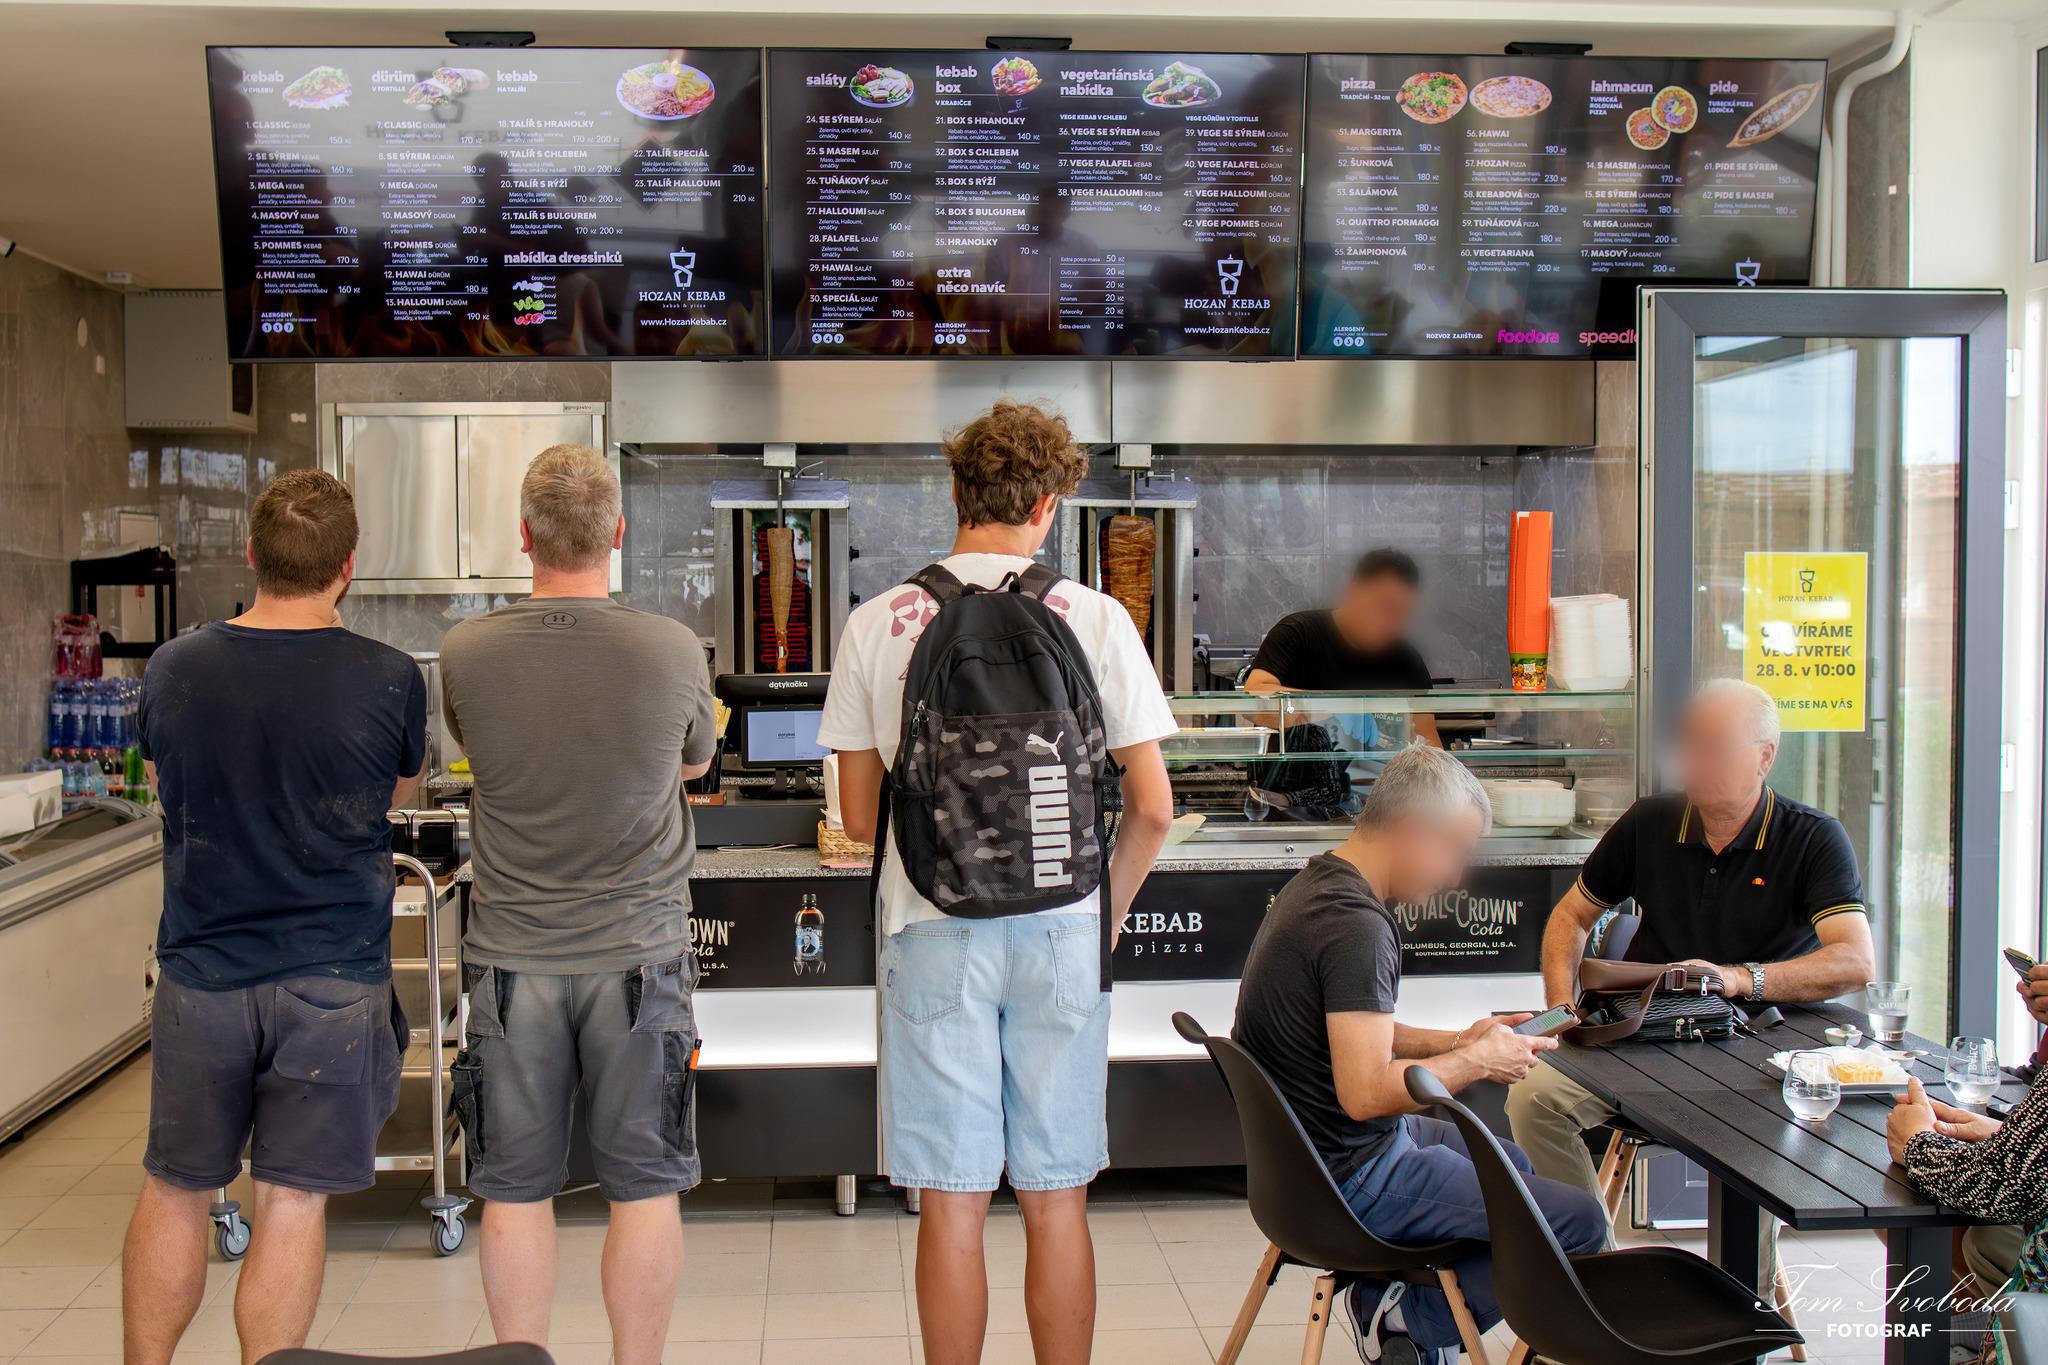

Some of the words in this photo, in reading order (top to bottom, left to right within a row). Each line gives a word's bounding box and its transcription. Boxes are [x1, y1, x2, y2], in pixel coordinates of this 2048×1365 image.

[242, 70, 284, 83] kebab
[372, 70, 415, 83] dürüm
[497, 70, 537, 82] kebab
[936, 66, 977, 78] kebab
[1061, 69, 1154, 81] vegetariánská
[807, 73, 846, 88] saláty
[1341, 77, 1375, 92] pizza
[936, 81, 961, 93] box
[1061, 84, 1113, 96] nabídka
[1592, 81, 1653, 92] lahmacun
[1710, 80, 1739, 94] pide
[832, 114, 863, 123] SÝREM
[975, 117, 1025, 125] HRANOLKY
[1339, 128, 1349, 136] 51.
[1350, 128, 1402, 136] MARGERITA
[634, 150, 645, 158] 22.
[646, 148, 671, 158] TALÍŘ
[673, 148, 709, 158] SPECIÁL
[1058, 159, 1069, 167] 37.
[1070, 159, 1093, 167] VEGE
[1350, 157, 1393, 167] ŠUNKOVÁ
[1749, 161, 1777, 171] SÝREM
[733, 165, 745, 173] 210
[819, 175, 869, 184] TUŇÁKOVÝ
[250, 182, 257, 190] 3.
[258, 182, 284, 190] MEGA
[260, 210, 299, 219] MASOVÝ
[502, 212, 512, 220] 21.
[513, 210, 538, 220] TALÍŘ
[548, 212, 597, 220] BULGUREM
[1221, 220, 1260, 228] POMMES
[1336, 219, 1347, 227] 54.
[1349, 219, 1390, 227] QUATTRO
[1392, 219, 1439, 227] FORMAGGI
[1474, 218, 1522, 228] TUŇÁKOVÁ
[1335, 248, 1345, 256] 55.
[1347, 246, 1407, 256] ŽAMPIONOVÁ
[1473, 249, 1534, 257] VEGETARIANA
[1581, 250, 1590, 258] 17.
[1591, 248, 1628, 258] MASOVÝ
[504, 251, 556, 263] nabídka
[558, 251, 622, 264] dressinků
[937, 267, 971, 278] extra
[936, 282, 969, 293] něco
[971, 281, 1005, 293] navíc
[639, 291, 681, 301] HOZAN
[688, 291, 726, 301] KEBAB
[823, 293, 860, 302] SPECIÁL
[1184, 299, 1226, 309] HOZAN
[1232, 298, 1270, 309] KEBAB
[640, 318, 726, 326] www.HozanKebab.cz
[1184, 325, 1270, 335] www.HozanKebab.cz
[1498, 329, 1559, 344] foodora
[1756, 664, 1779, 676] 28.
[1784, 664, 1798, 676] 8.
[1802, 666, 1811, 676] v
[1815, 664, 1855, 676] 10:00
[1798, 700, 1810, 708] SE
[1812, 700, 1828, 708] NA
[1830, 698, 1853, 708] VÁS
[1029, 765, 1072, 888] PUMA
[1444, 889, 1517, 928] CROWN
[1120, 912, 1203, 933] KEBAB
[688, 918, 728, 946] OWN
[1470, 923, 1503, 935] Cola
[1135, 941, 1203, 956] pizza
